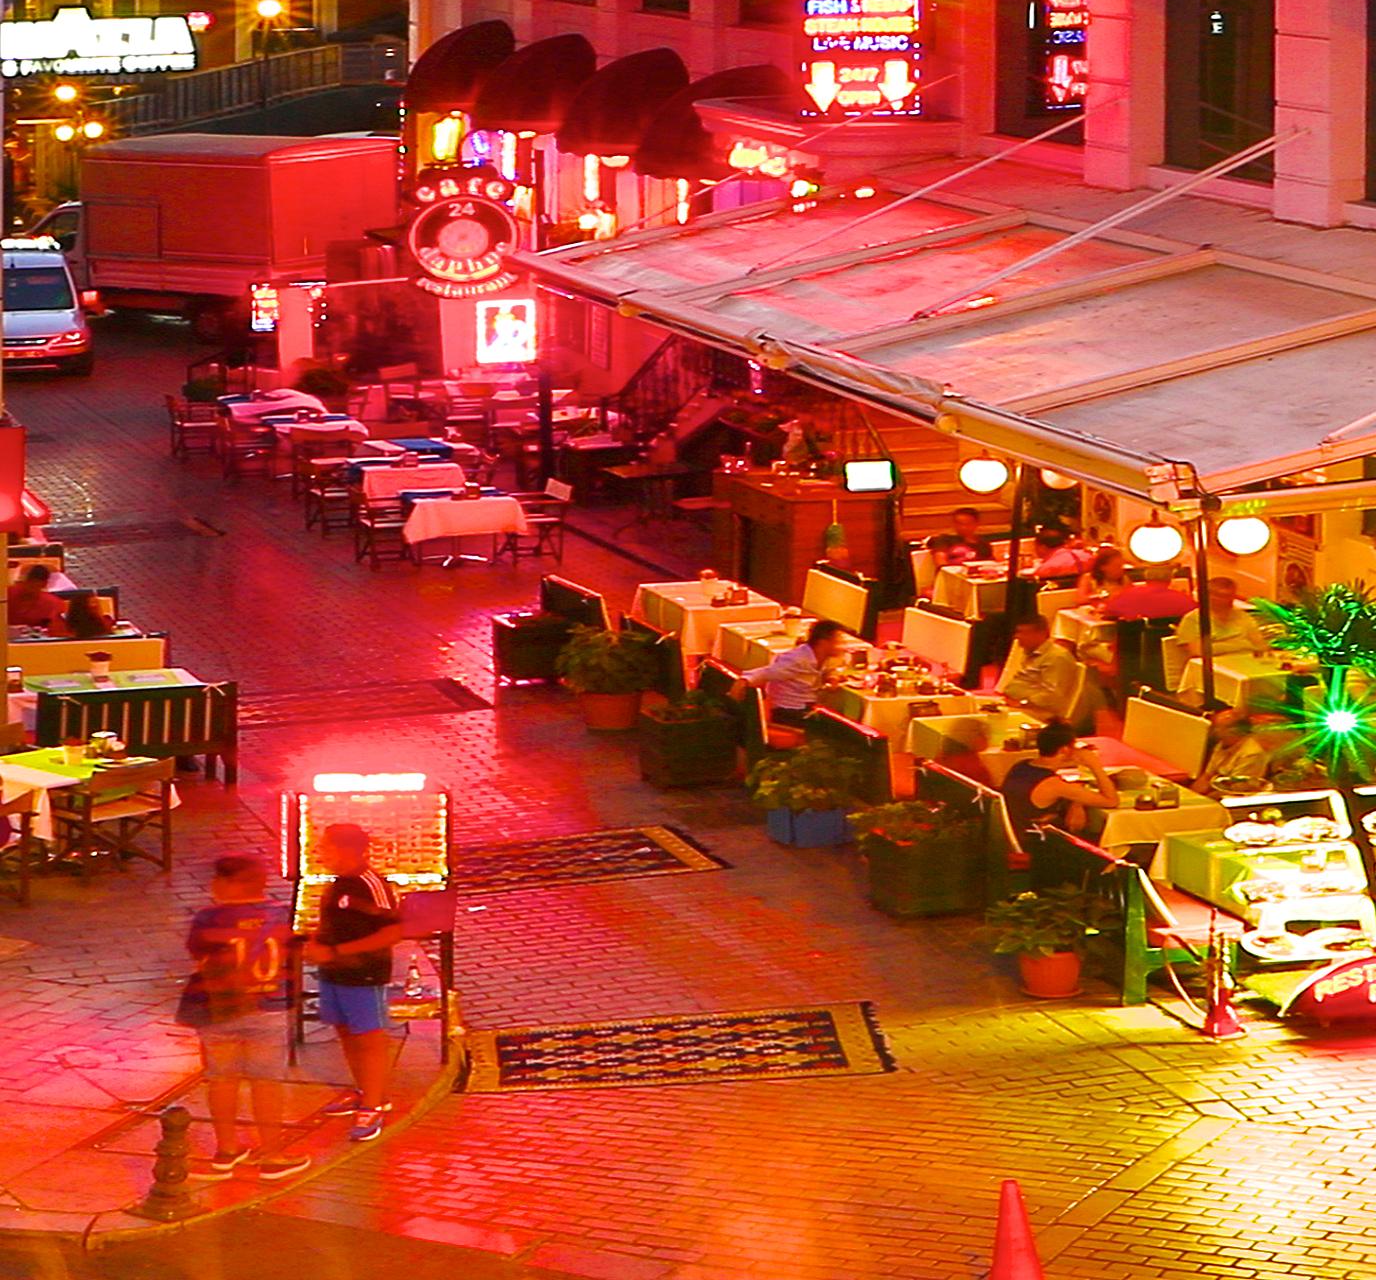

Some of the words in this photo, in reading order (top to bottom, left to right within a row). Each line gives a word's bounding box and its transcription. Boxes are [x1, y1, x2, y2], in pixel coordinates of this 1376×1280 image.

[807, 0, 848, 14] FISH
[853, 35, 909, 51] MUSIC
[448, 202, 476, 217] 24
